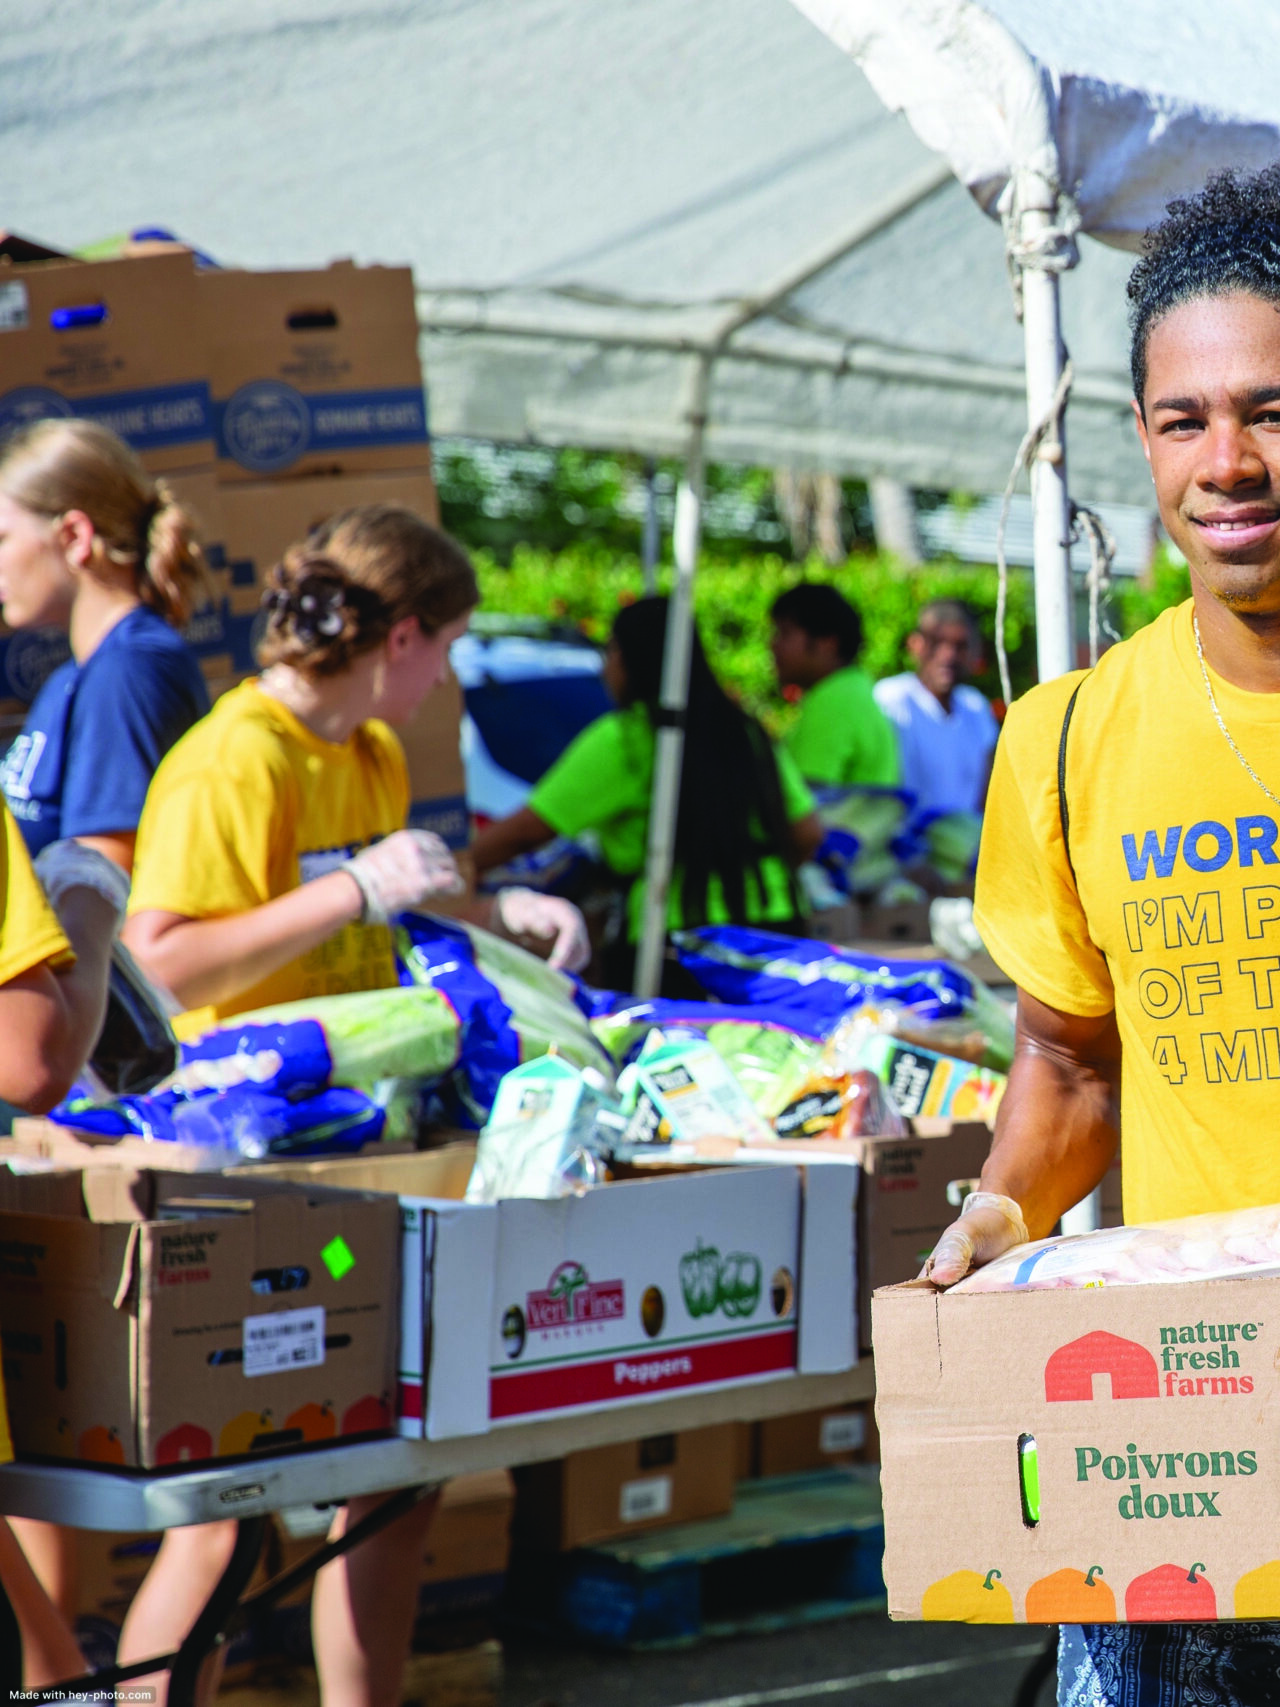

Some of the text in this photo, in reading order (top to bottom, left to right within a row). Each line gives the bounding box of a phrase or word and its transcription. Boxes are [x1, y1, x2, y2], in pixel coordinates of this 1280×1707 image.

[1123, 891, 1223, 952] I'M
[1138, 962, 1222, 1019] OF
[1152, 1035, 1188, 1085] 4
[614, 1355, 692, 1385] Peppers
[1160, 1343, 1241, 1371] fresh
[1163, 1372, 1254, 1397] farms
[1074, 1443, 1258, 1482] Poivrons
[1118, 1484, 1222, 1520] doux
